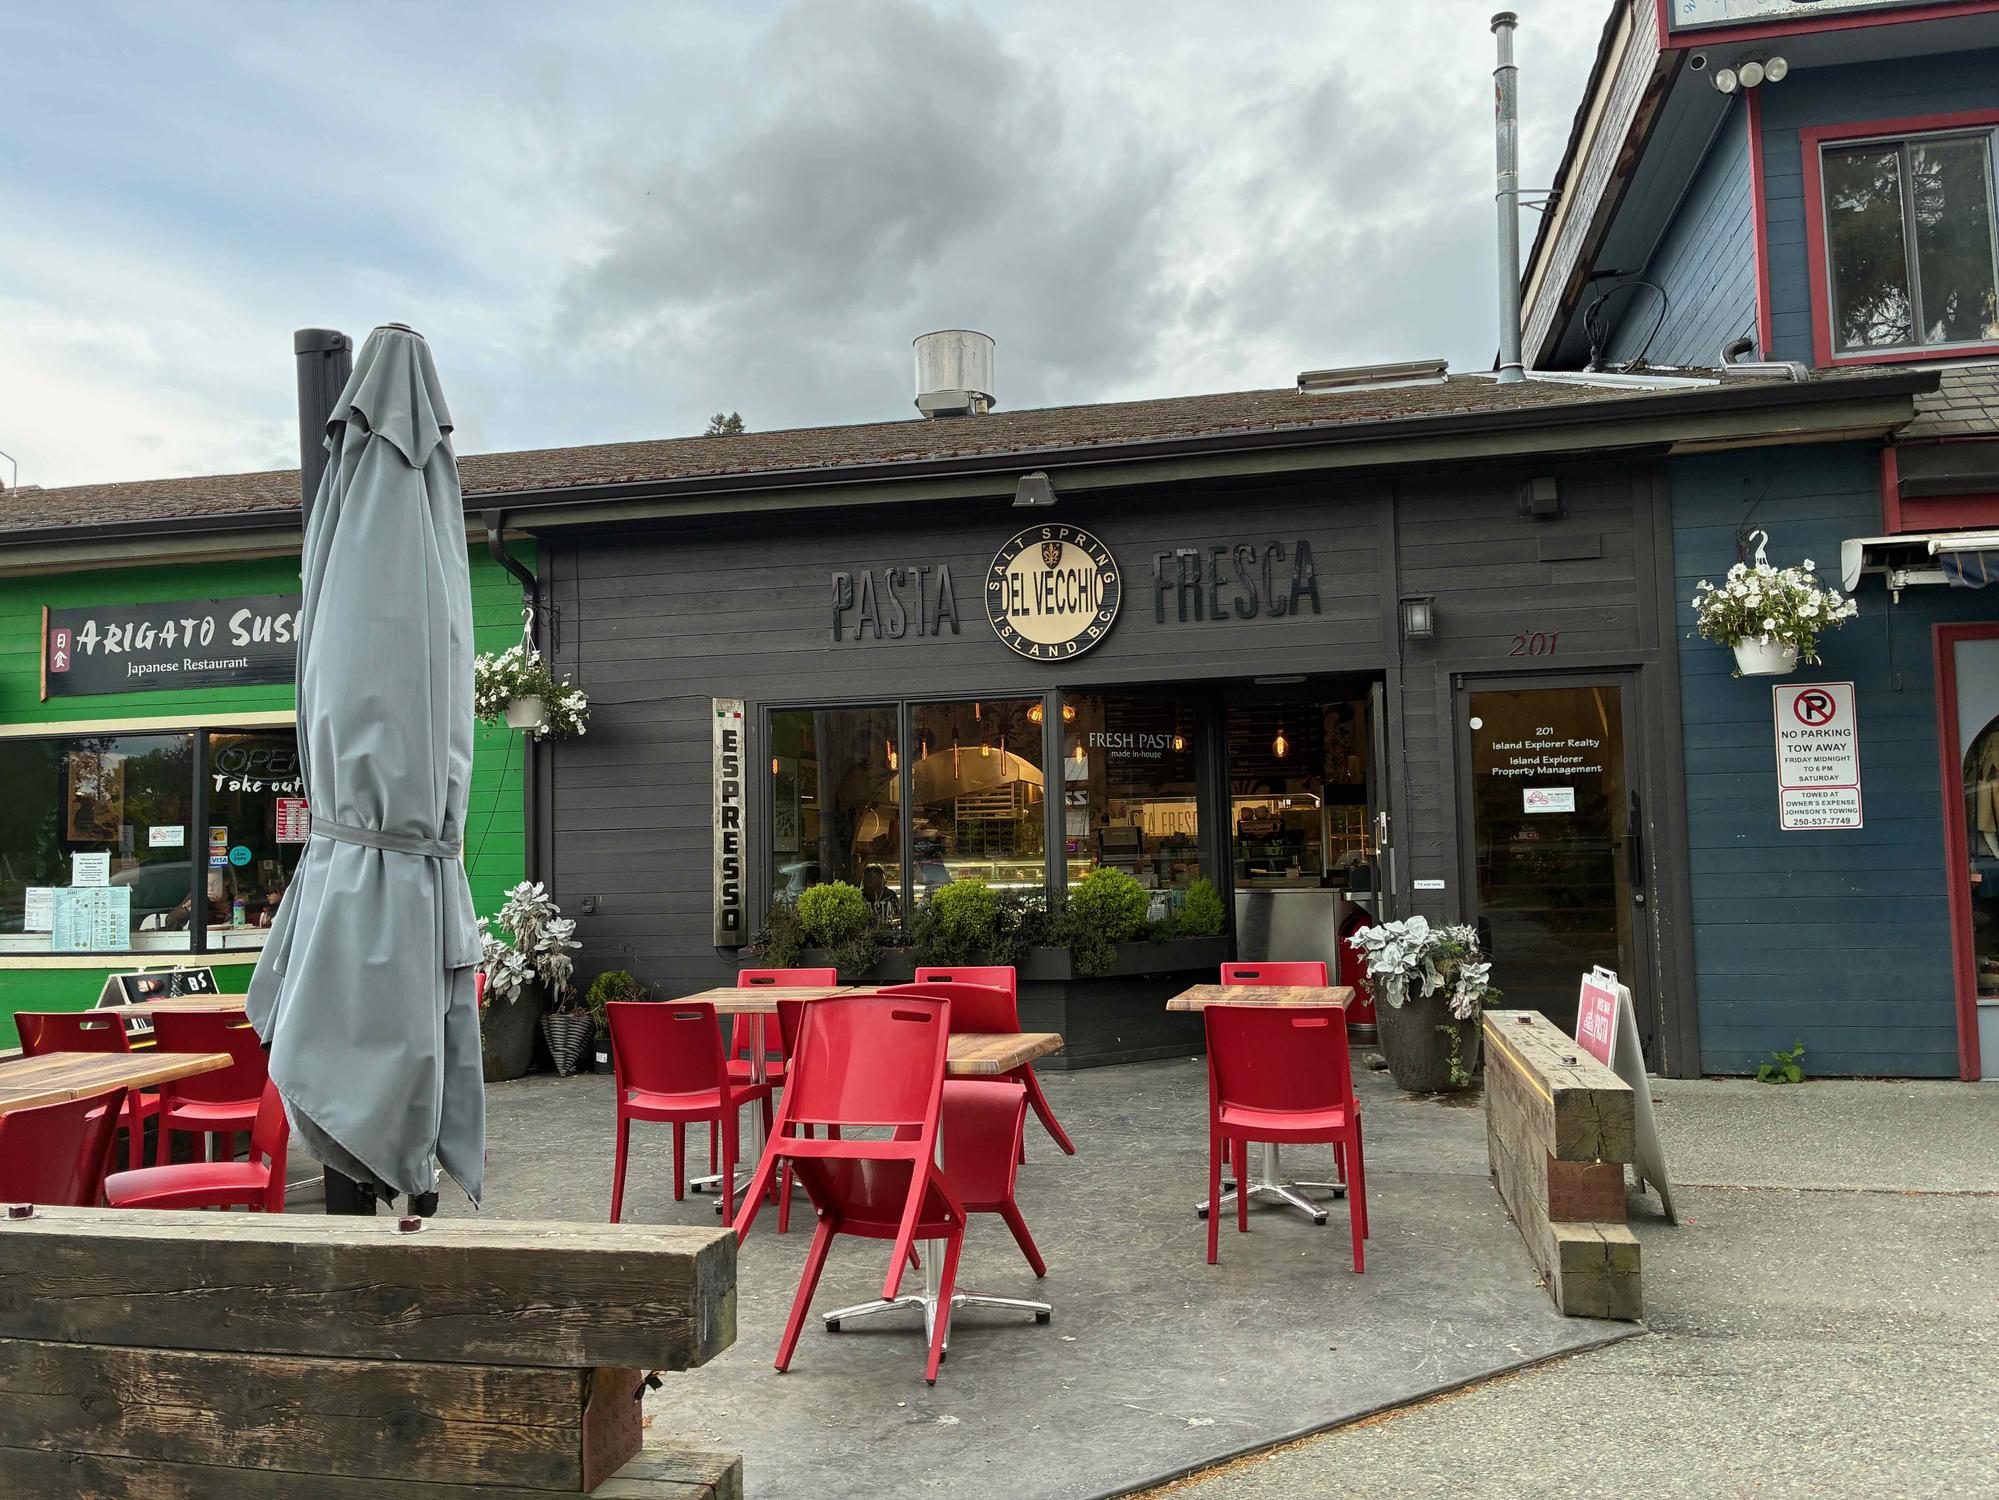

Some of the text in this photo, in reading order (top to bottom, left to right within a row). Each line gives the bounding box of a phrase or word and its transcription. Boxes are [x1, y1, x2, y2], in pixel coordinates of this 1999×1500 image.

[989, 527, 1115, 591] SALT SPRING
[1152, 540, 1321, 624] FRESCA
[1002, 567, 1104, 617] DEL VECCHIO
[831, 564, 960, 641] PASTA
[77, 608, 303, 656] ARIGATO SUS
[994, 608, 1115, 657] ISLAND B.C.
[1509, 631, 1559, 657] 201
[127, 657, 249, 678] Japanese Restaurant
[1535, 727, 1554, 736] 201
[1781, 728, 1852, 739] NO PARKING
[1089, 732, 1134, 749] FRESH
[1492, 738, 1600, 751] Island Explorer Realty
[1787, 743, 1848, 753] TOW AWAY
[1111, 750, 1162, 758] made in-house
[1509, 755, 1584, 768] Island Explorer
[1813, 755, 1852, 763] MIDNIGHT
[1491, 764, 1603, 778] Property Management
[1798, 774, 1840, 782] SATURDAY
[212, 774, 304, 793] Take out
[1793, 817, 1851, 826] 250-537-7749
[721, 729, 741, 932] ESPRESSO
